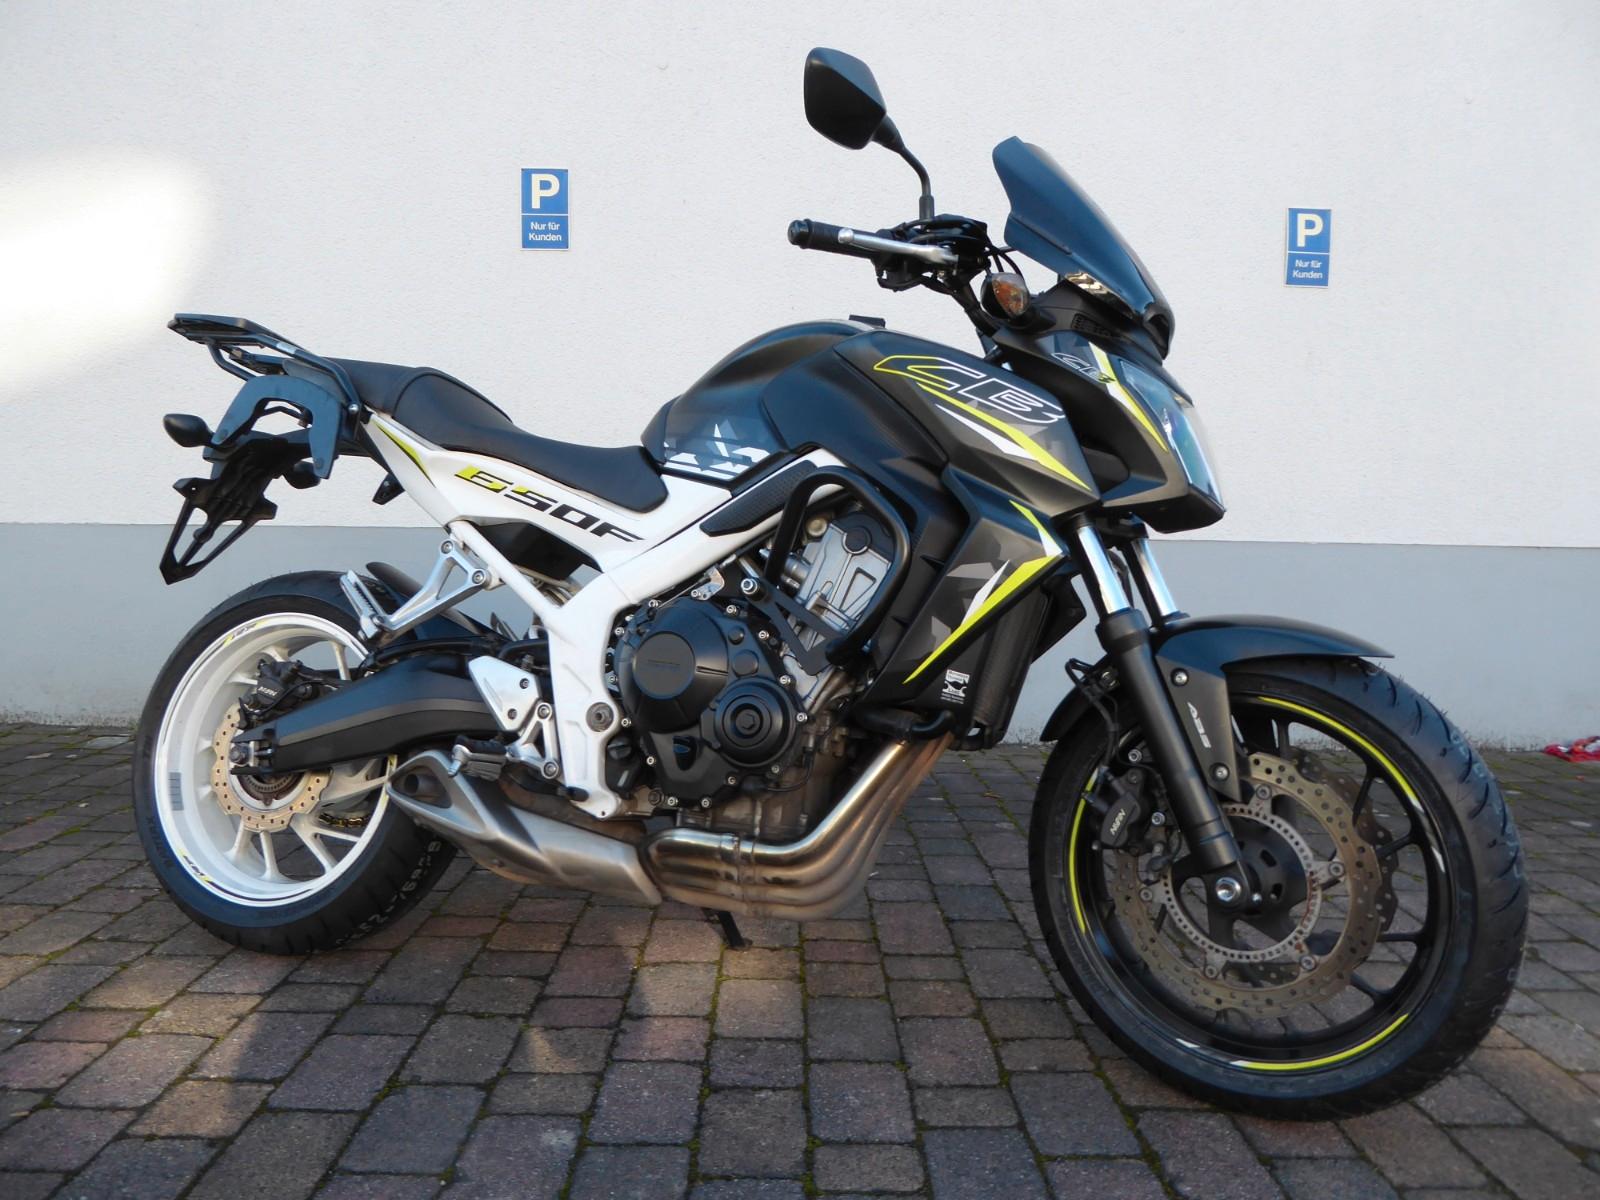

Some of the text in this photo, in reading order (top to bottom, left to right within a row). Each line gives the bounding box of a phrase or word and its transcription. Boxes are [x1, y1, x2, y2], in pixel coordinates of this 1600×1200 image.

[531, 173, 560, 209] P
[528, 233, 562, 241] Kunden
[530, 221, 560, 231] Nur für
[1297, 213, 1324, 248] P
[1292, 270, 1323, 279] Kunden
[1295, 259, 1322, 268] Nur für
[873, 355, 1066, 424] CB
[454, 466, 645, 542] 650F
